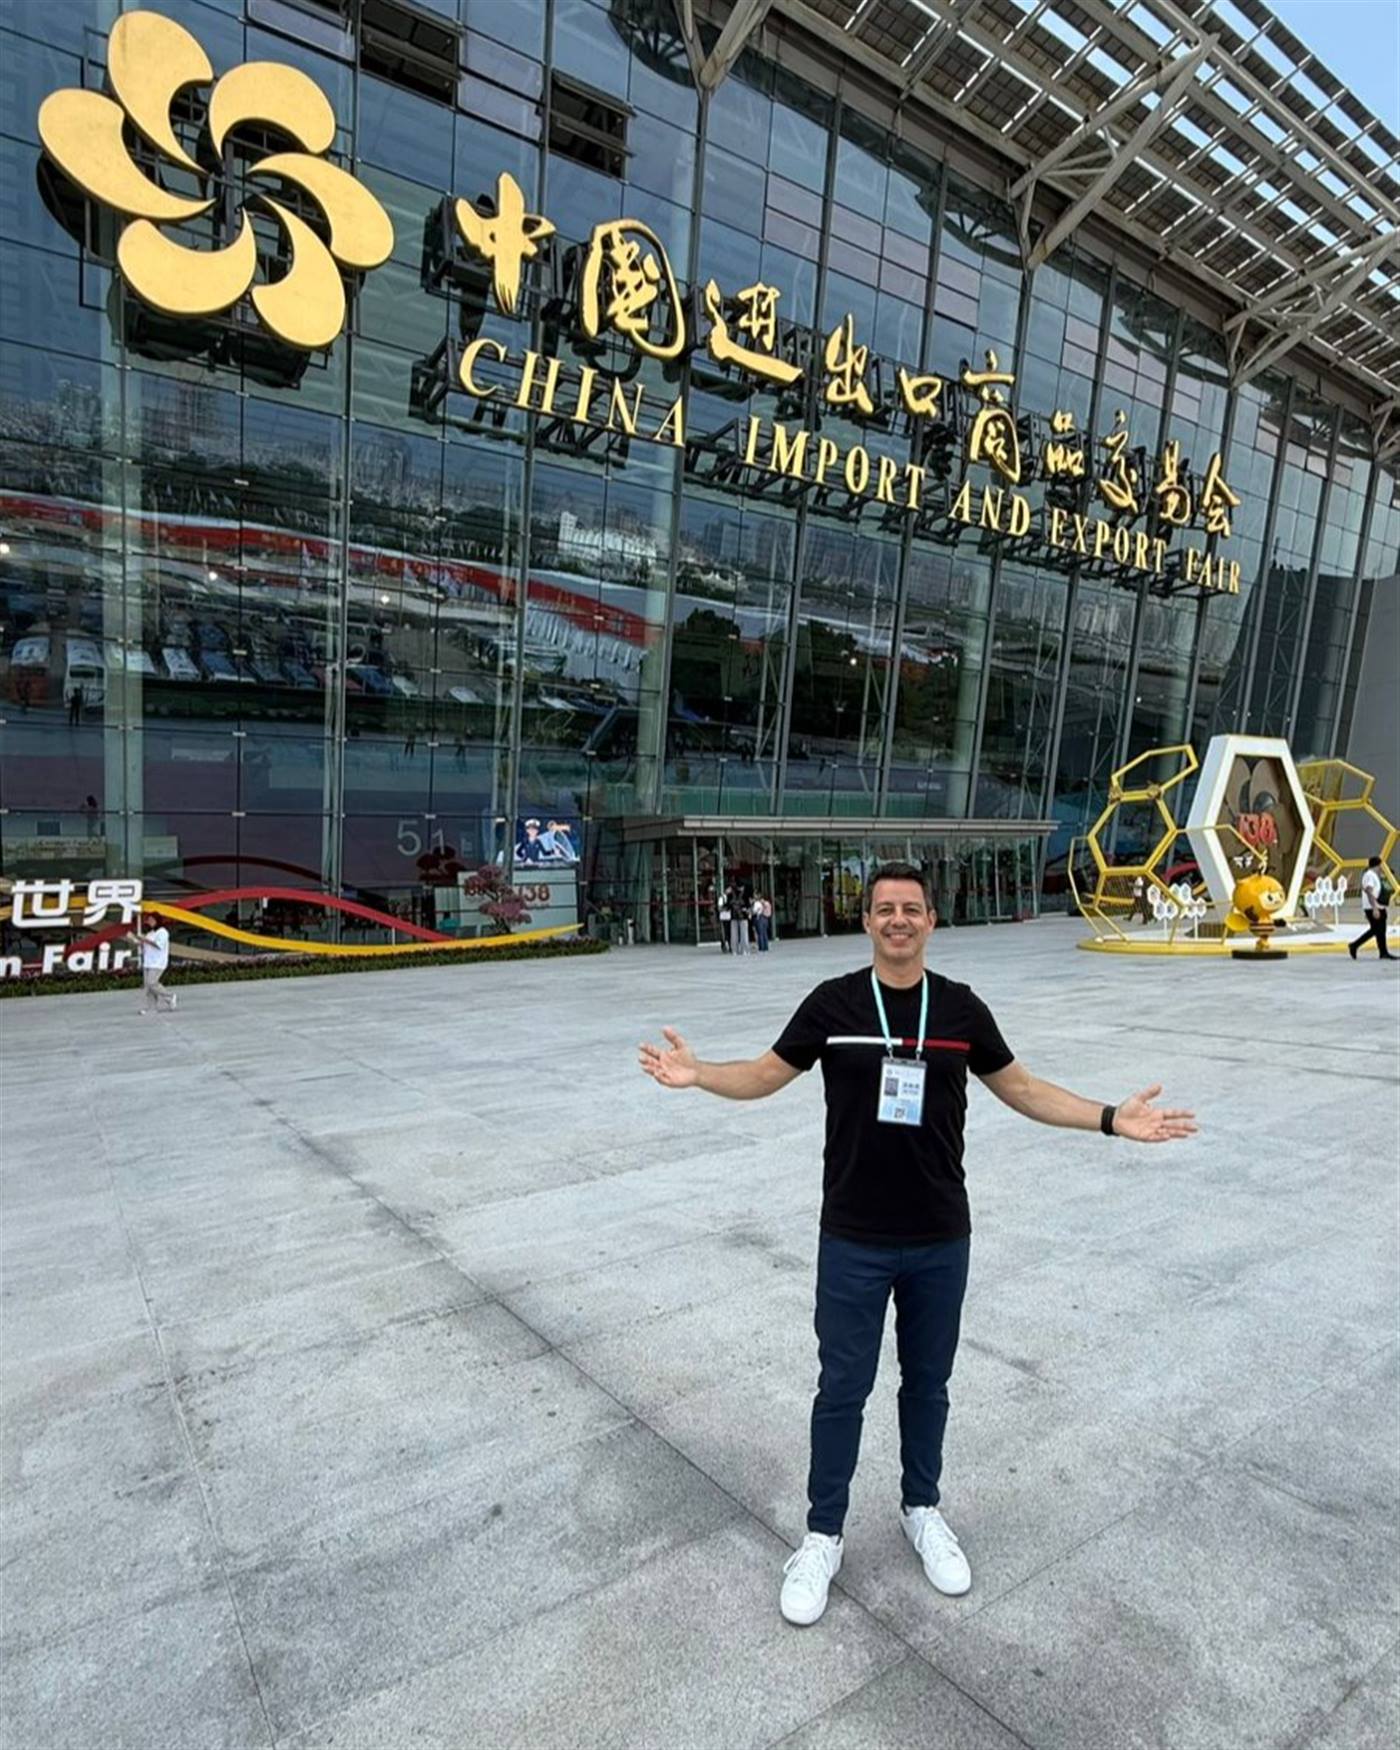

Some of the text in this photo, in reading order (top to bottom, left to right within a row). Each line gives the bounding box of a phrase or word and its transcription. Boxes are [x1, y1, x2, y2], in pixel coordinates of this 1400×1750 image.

[459, 337, 1240, 594] CHINA IMPORT AND EXPORT FAIR
[11, 879, 143, 928] 世界
[42, 942, 131, 973] Fair
